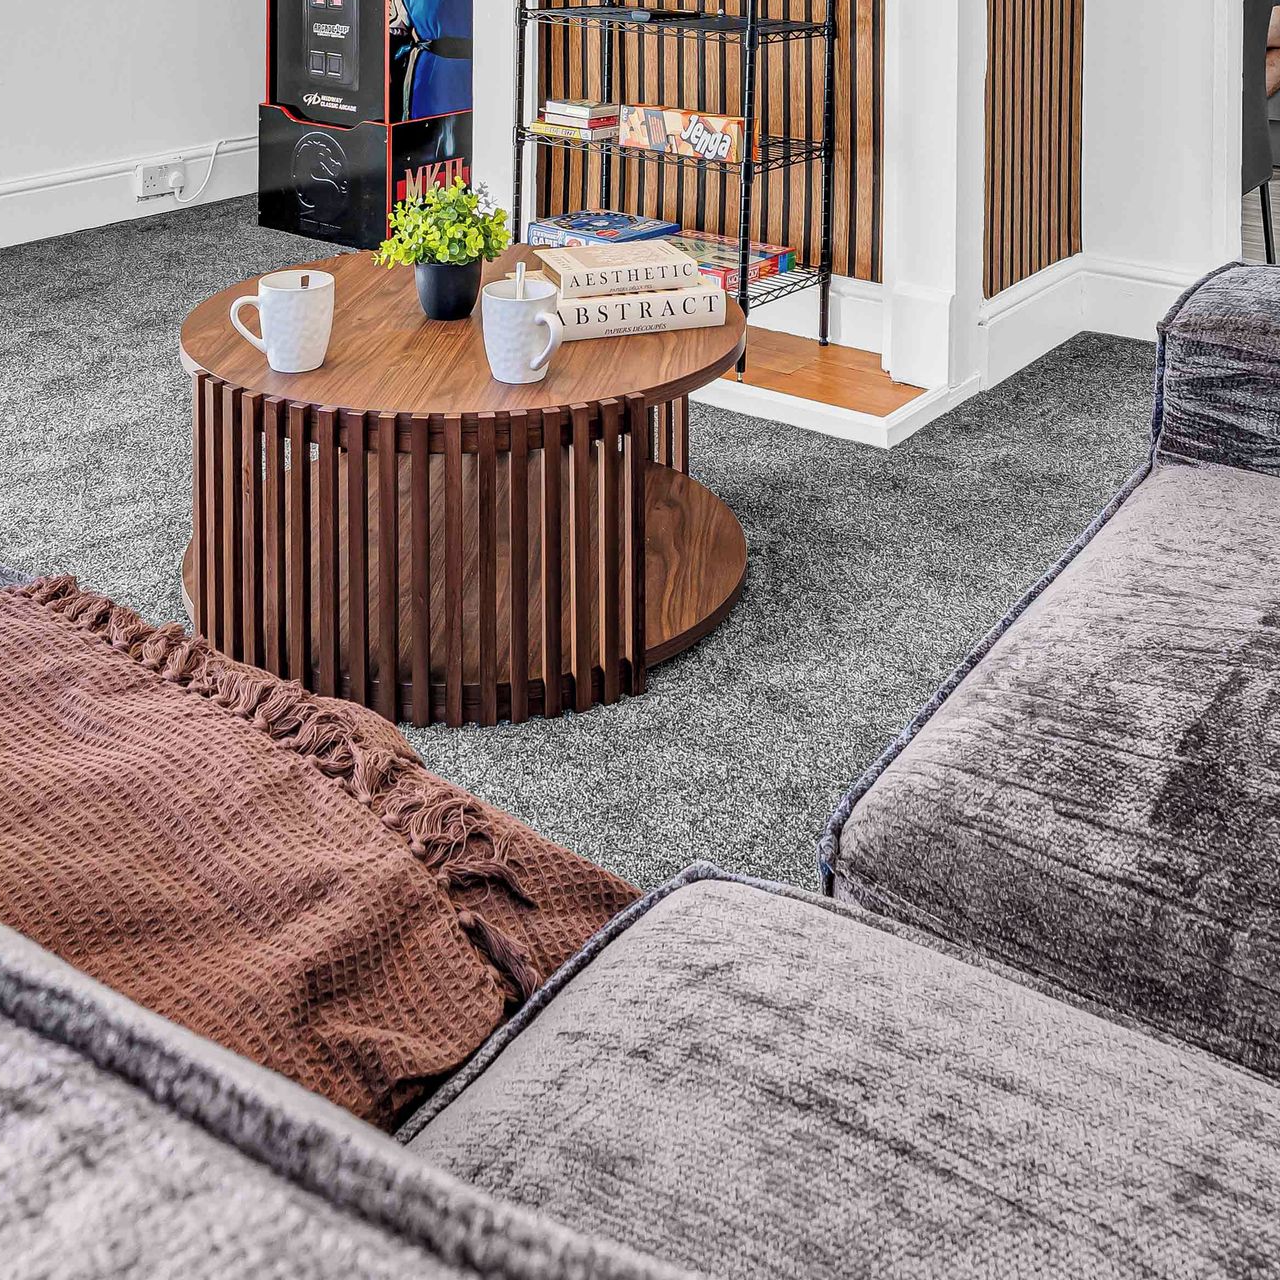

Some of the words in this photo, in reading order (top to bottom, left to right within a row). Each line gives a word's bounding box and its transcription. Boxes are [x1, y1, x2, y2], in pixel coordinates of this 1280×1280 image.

[681, 114, 732, 160] Jenga
[570, 263, 693, 288] AESTHETIC
[604, 326, 632, 335] PAPIERS
